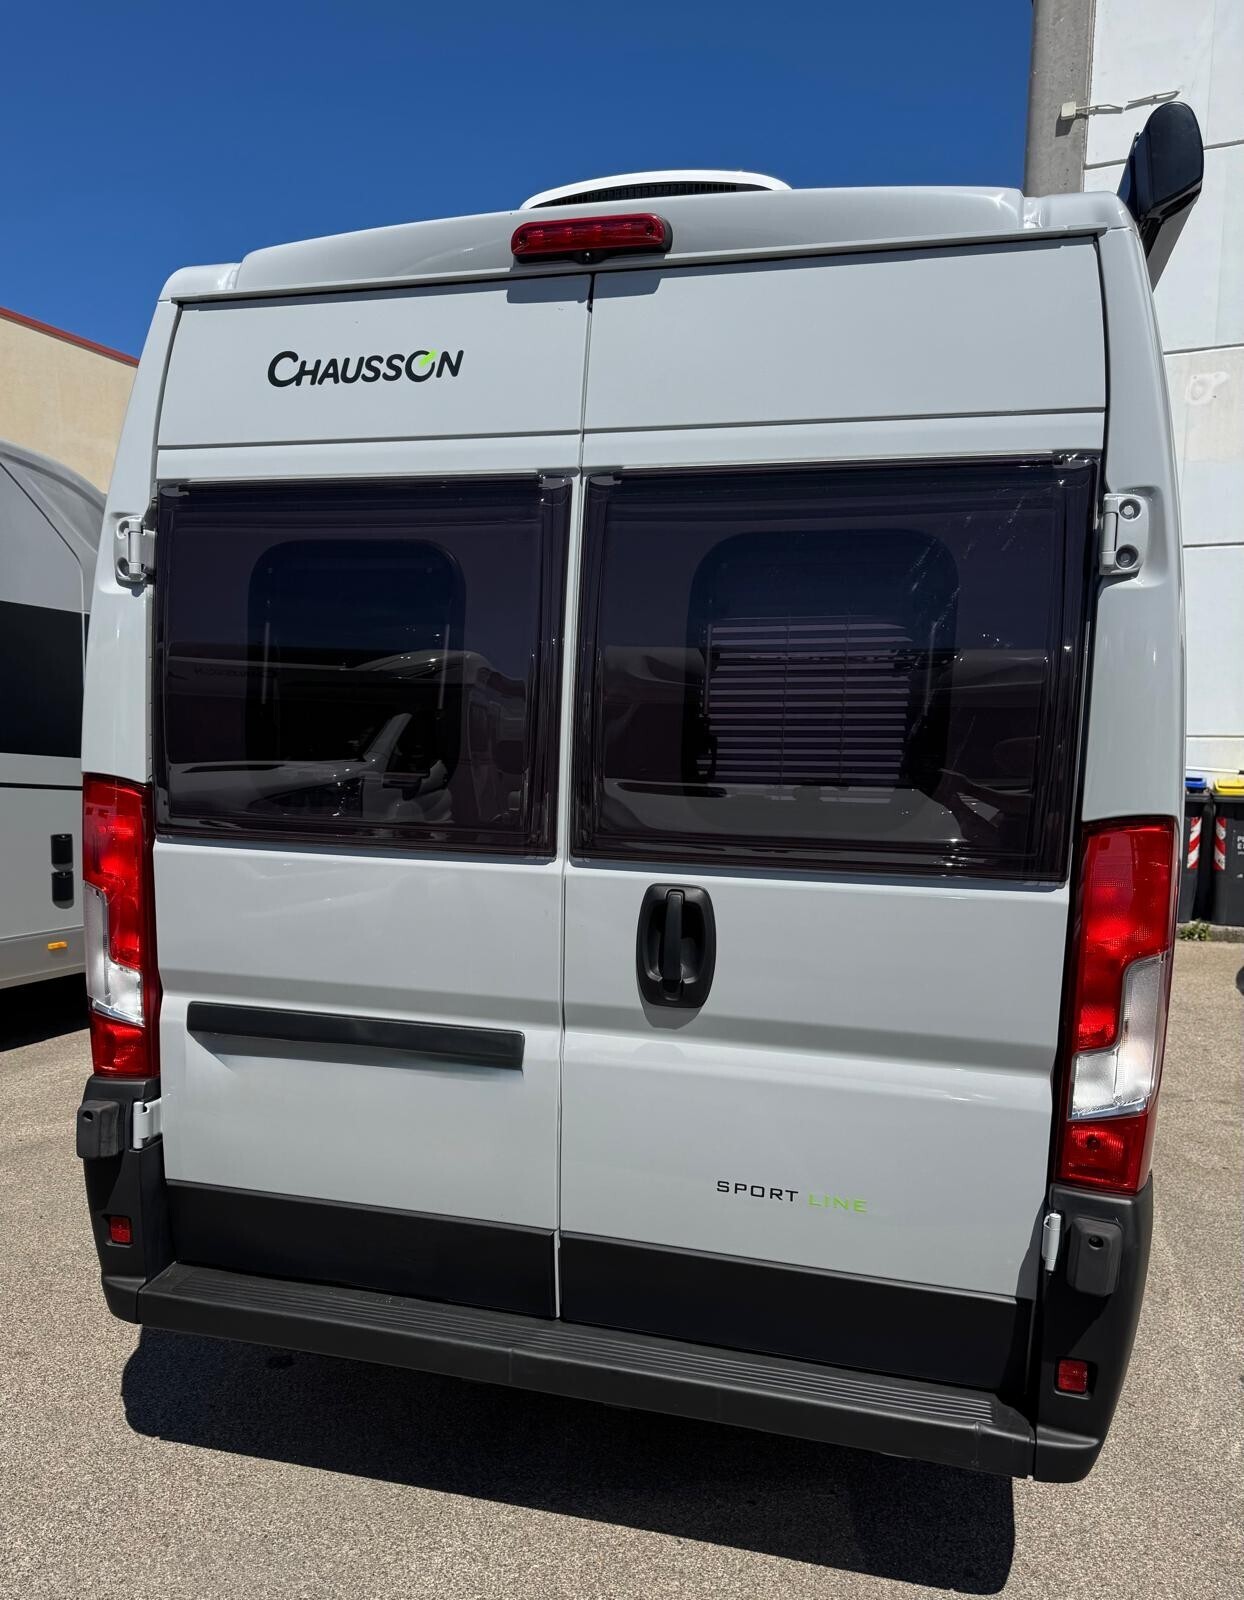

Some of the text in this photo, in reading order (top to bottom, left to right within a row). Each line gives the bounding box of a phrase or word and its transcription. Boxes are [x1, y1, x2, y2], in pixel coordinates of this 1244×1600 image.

[267, 350, 464, 388] CHAUSSON
[716, 1180, 868, 1213] SPORT LINE
